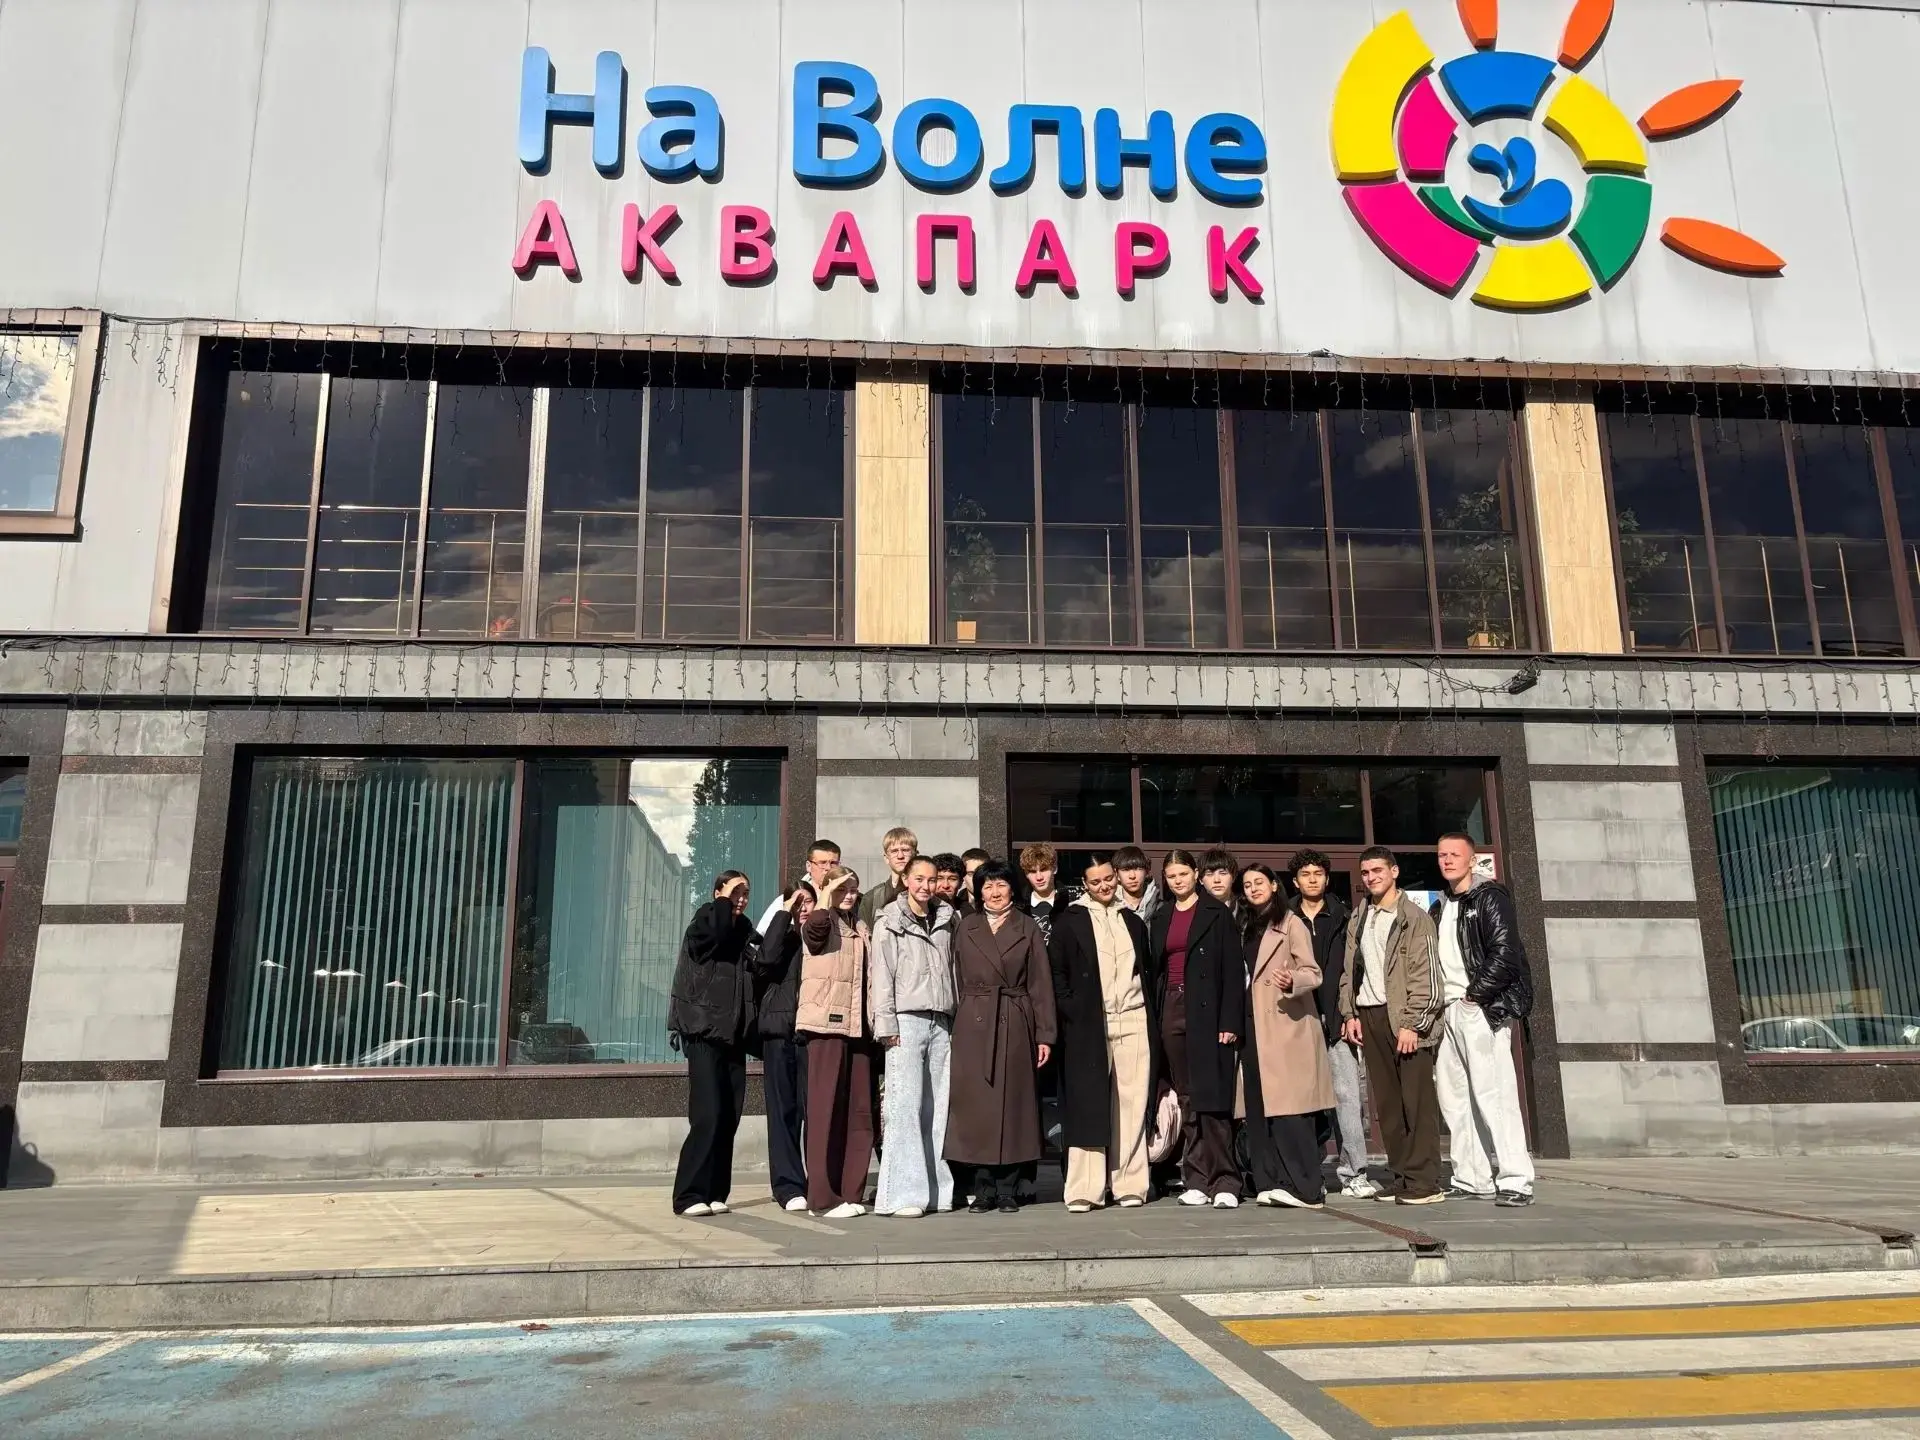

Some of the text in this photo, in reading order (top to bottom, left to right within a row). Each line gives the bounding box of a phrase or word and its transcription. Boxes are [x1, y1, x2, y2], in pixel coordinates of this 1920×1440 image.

[519, 45, 1268, 201] На Волне
[512, 199, 1265, 300] АКВАПАРК
